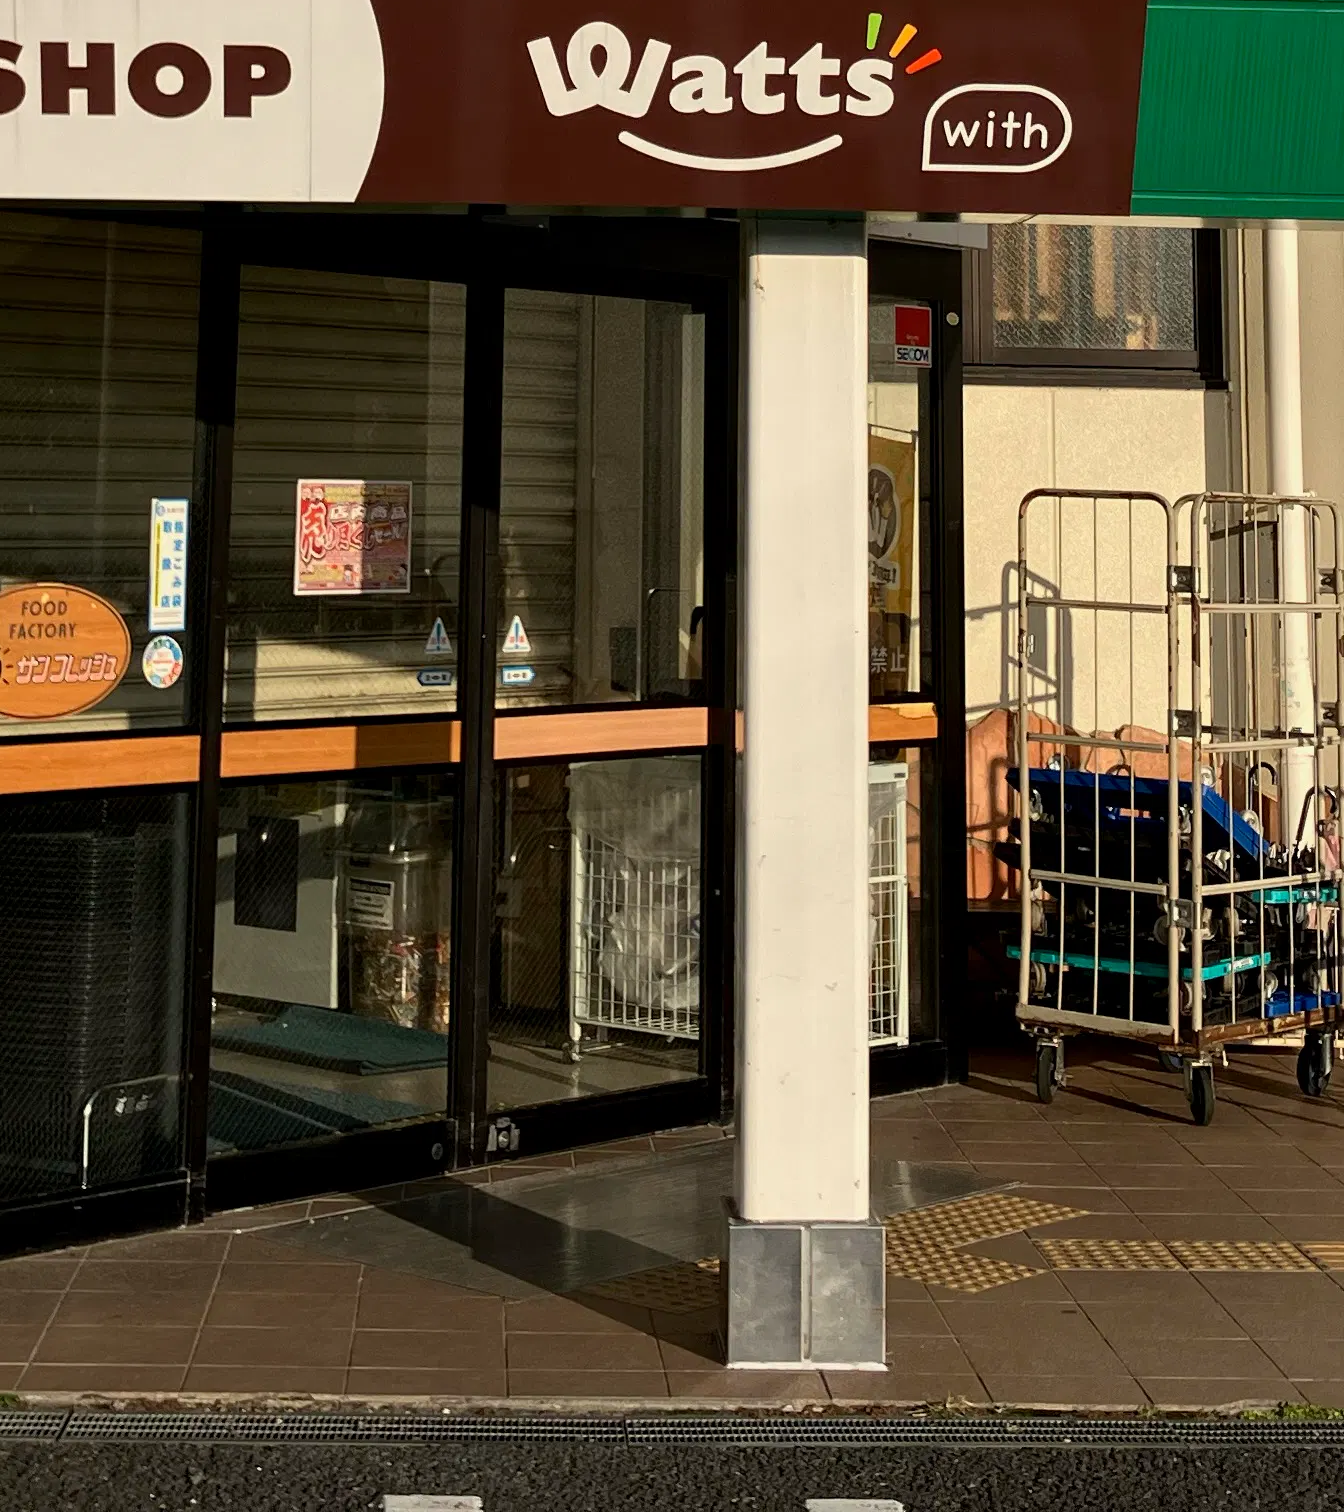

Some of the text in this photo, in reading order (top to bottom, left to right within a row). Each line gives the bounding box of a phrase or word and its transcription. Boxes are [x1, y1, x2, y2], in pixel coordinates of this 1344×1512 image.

[526, 21, 895, 118] Watts
[943, 110, 1049, 149] with
[897, 347, 929, 362] SECOM
[21, 600, 68, 617] FOOD
[9, 623, 77, 640] FACTORY
[16, 652, 119, 685] サンフレッシュ
